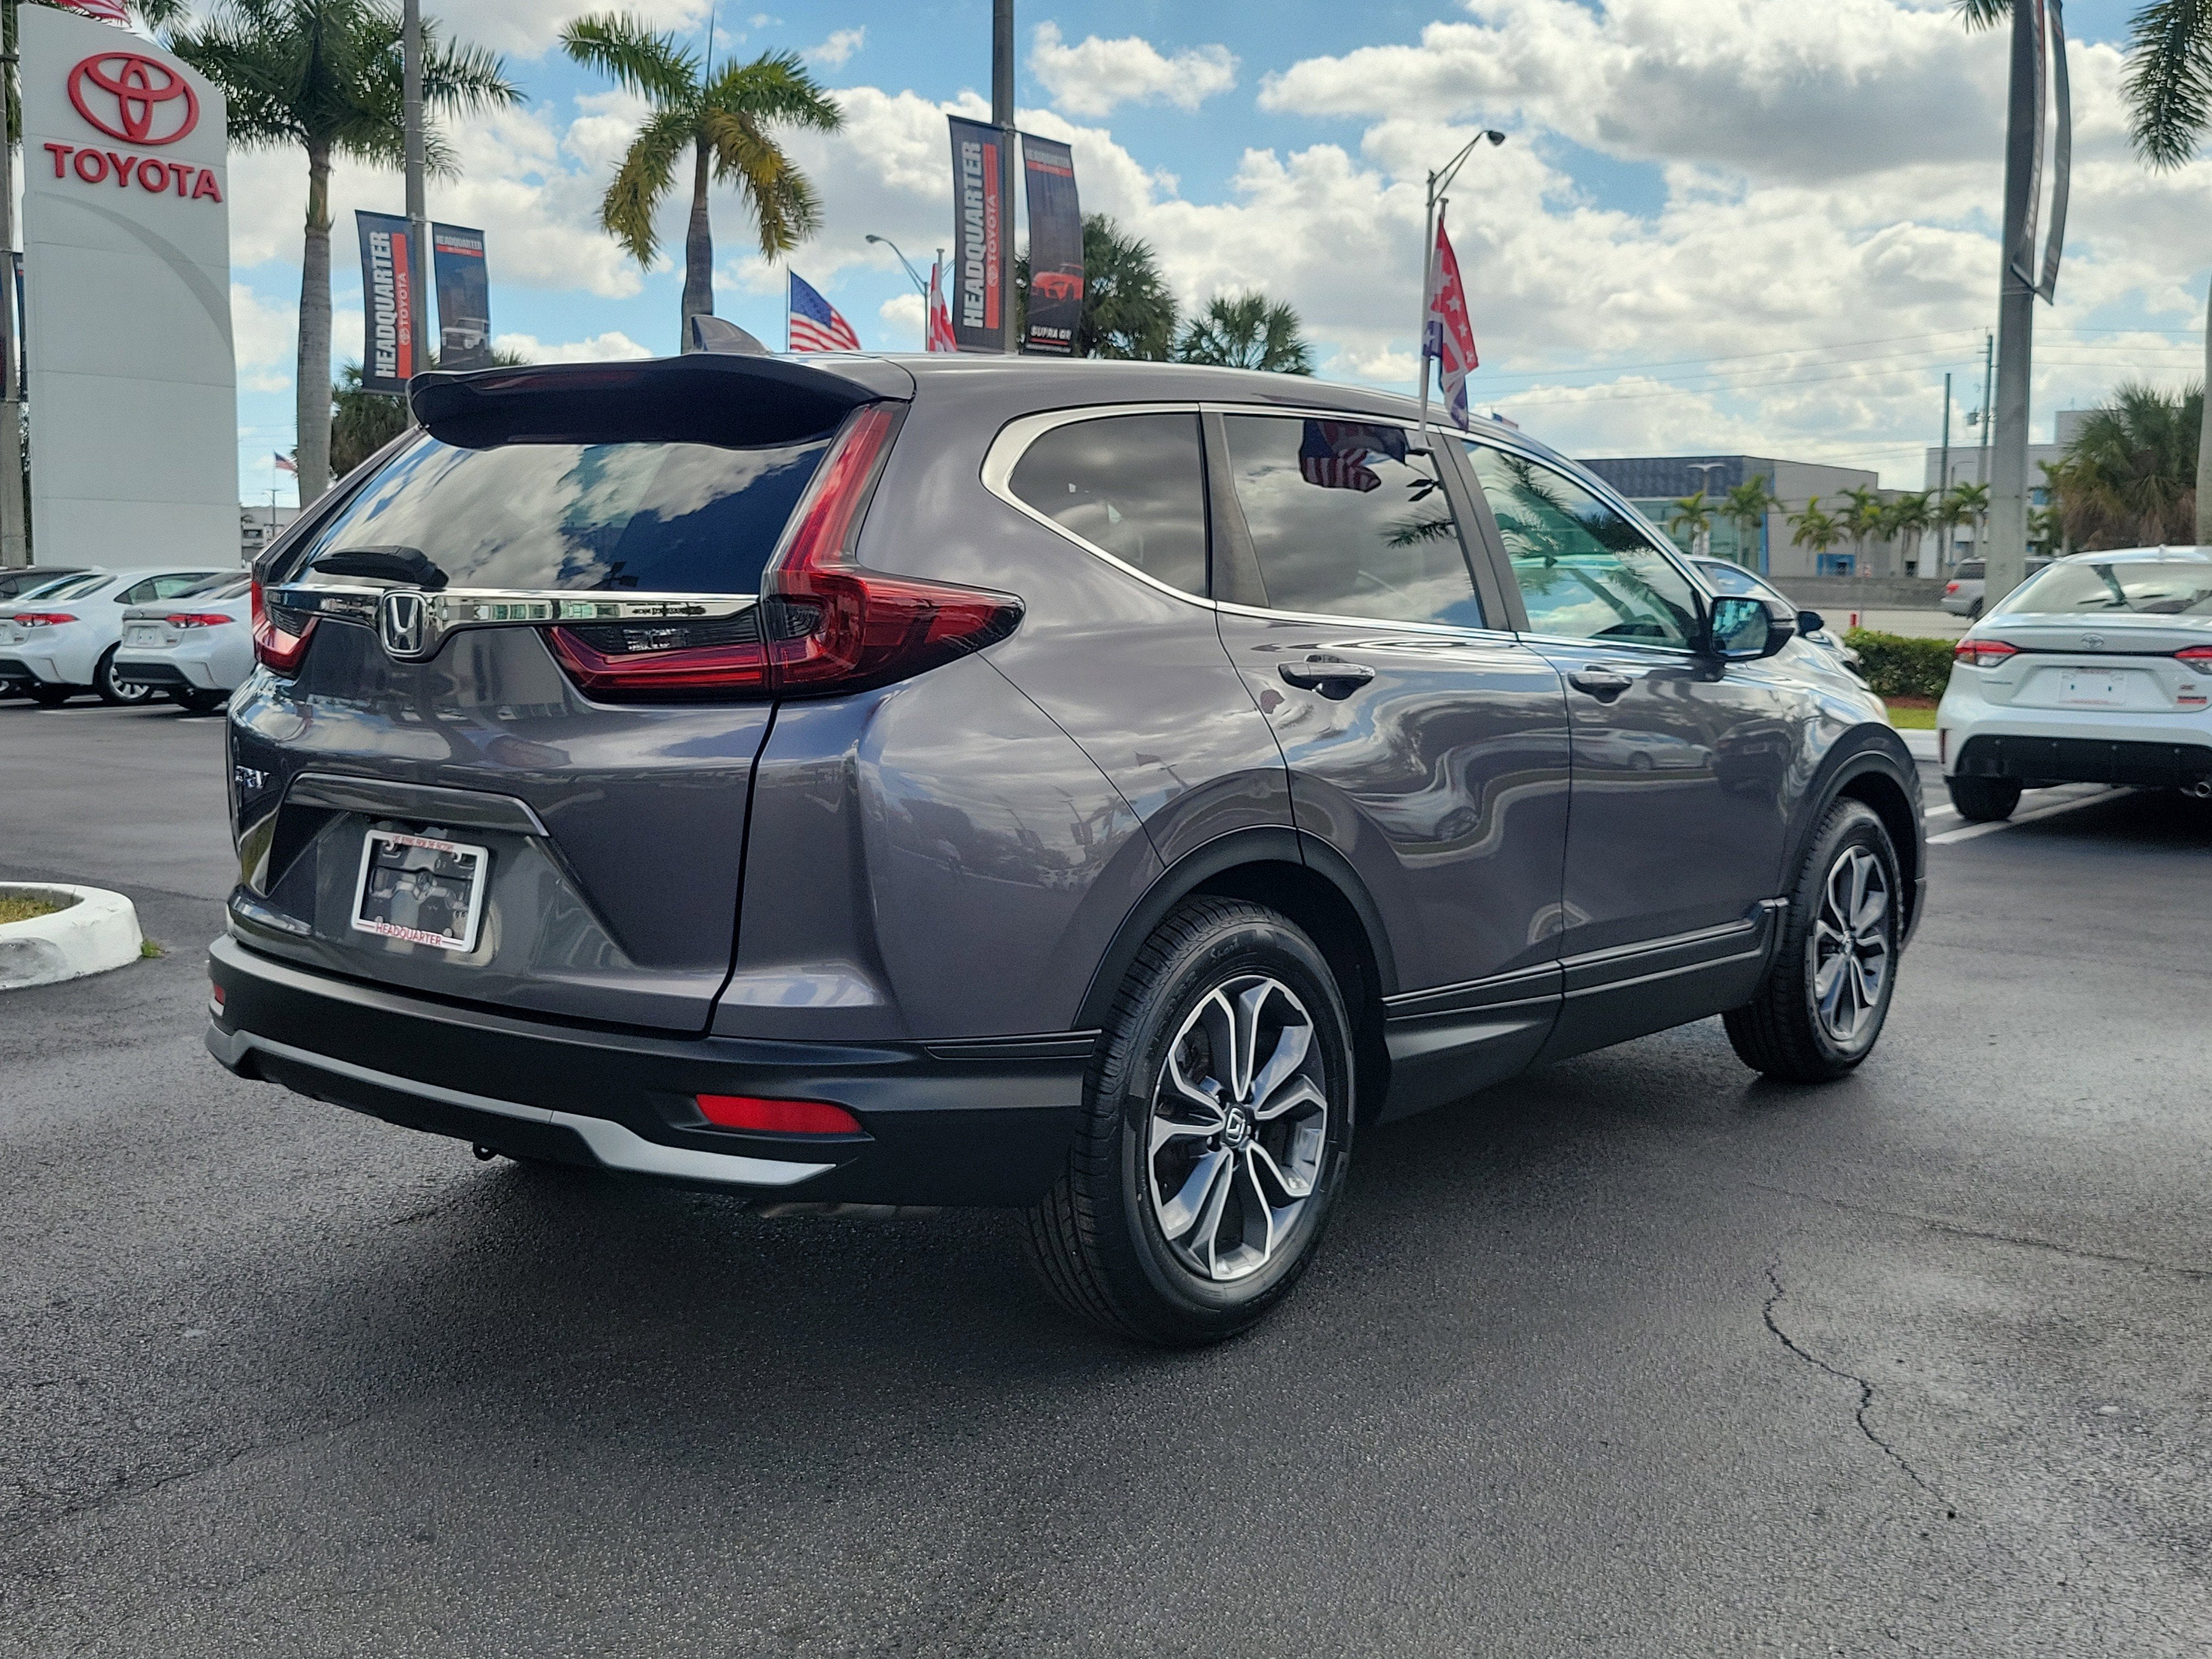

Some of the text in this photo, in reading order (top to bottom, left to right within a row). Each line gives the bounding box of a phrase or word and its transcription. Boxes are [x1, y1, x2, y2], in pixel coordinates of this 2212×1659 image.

[44, 142, 222, 204] TOYOTA
[962, 140, 986, 328] HEADQUARTER
[988, 195, 998, 261] TOYOTA
[369, 232, 397, 379] HEADQUARTER
[398, 272, 409, 326] TOYOTA
[376, 922, 442, 945] HEADQUARTER
